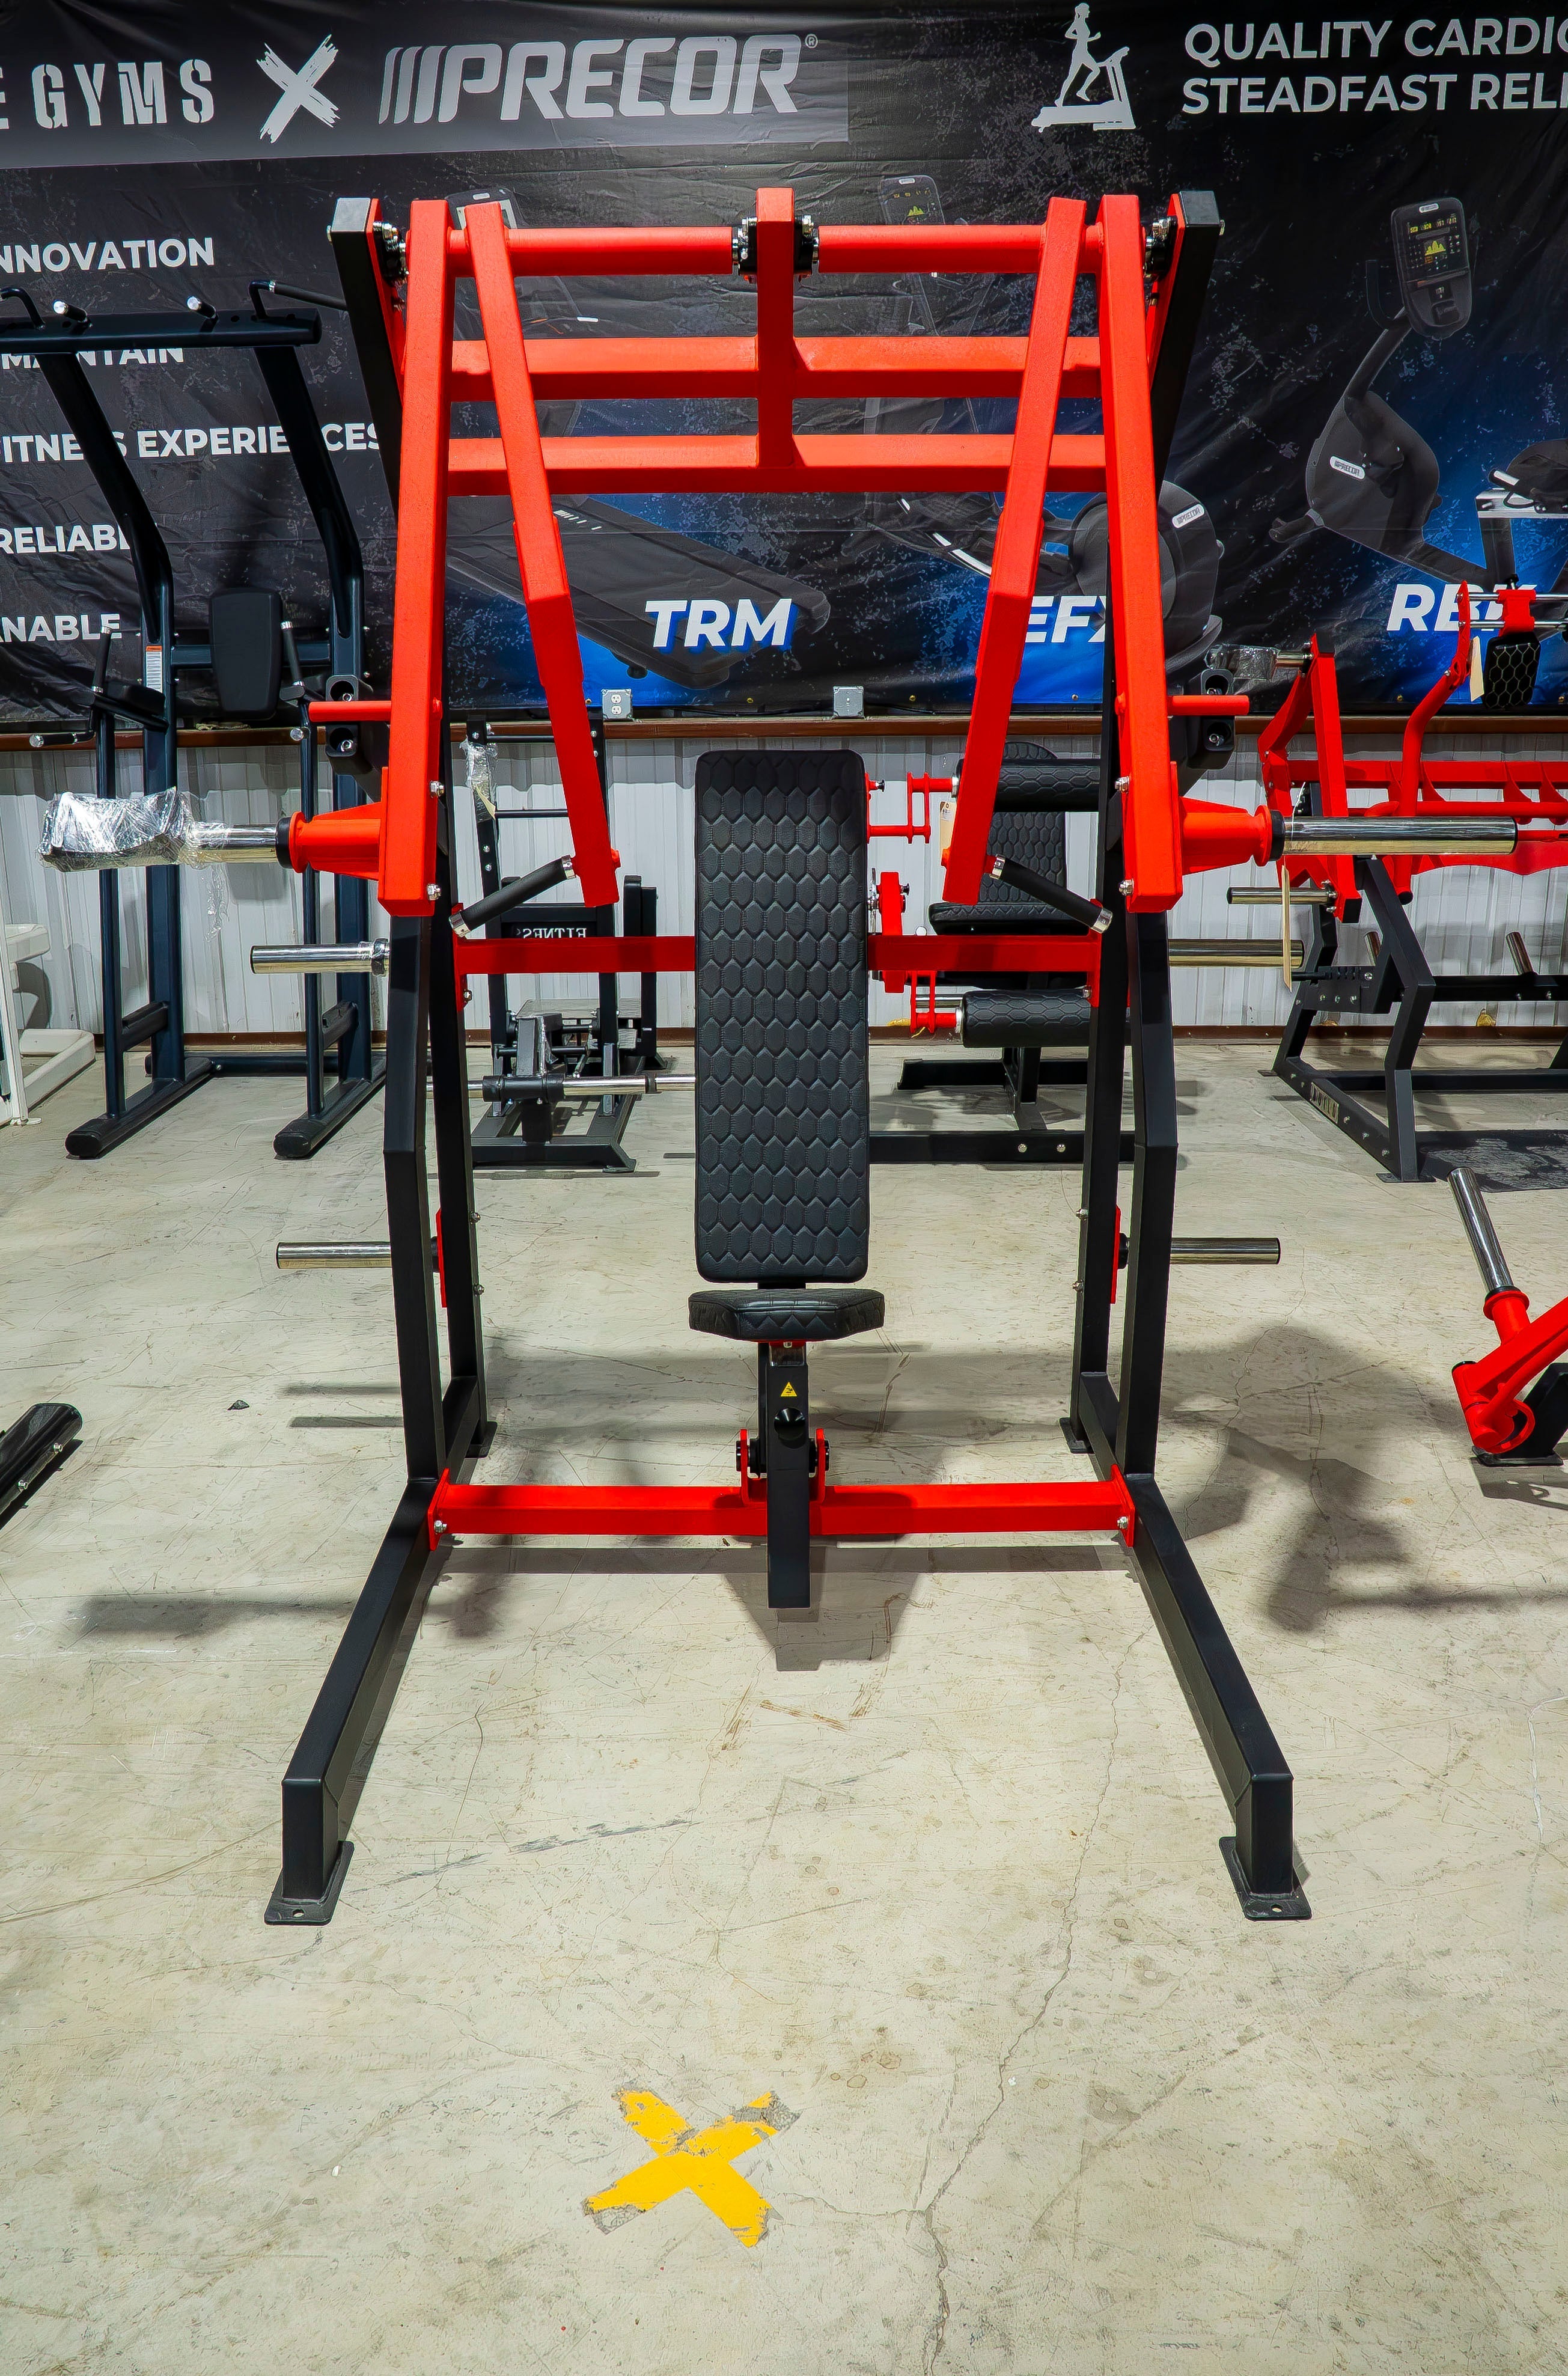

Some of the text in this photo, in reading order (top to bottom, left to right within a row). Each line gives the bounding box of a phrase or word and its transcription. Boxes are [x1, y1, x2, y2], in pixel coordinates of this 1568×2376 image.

[1185, 20, 1393, 67] QUALITY
[31, 59, 215, 129] GYMS
[1182, 74, 1457, 114] STEADFAST
[0, 613, 123, 643] NABLE
[644, 598, 792, 648] TRM
